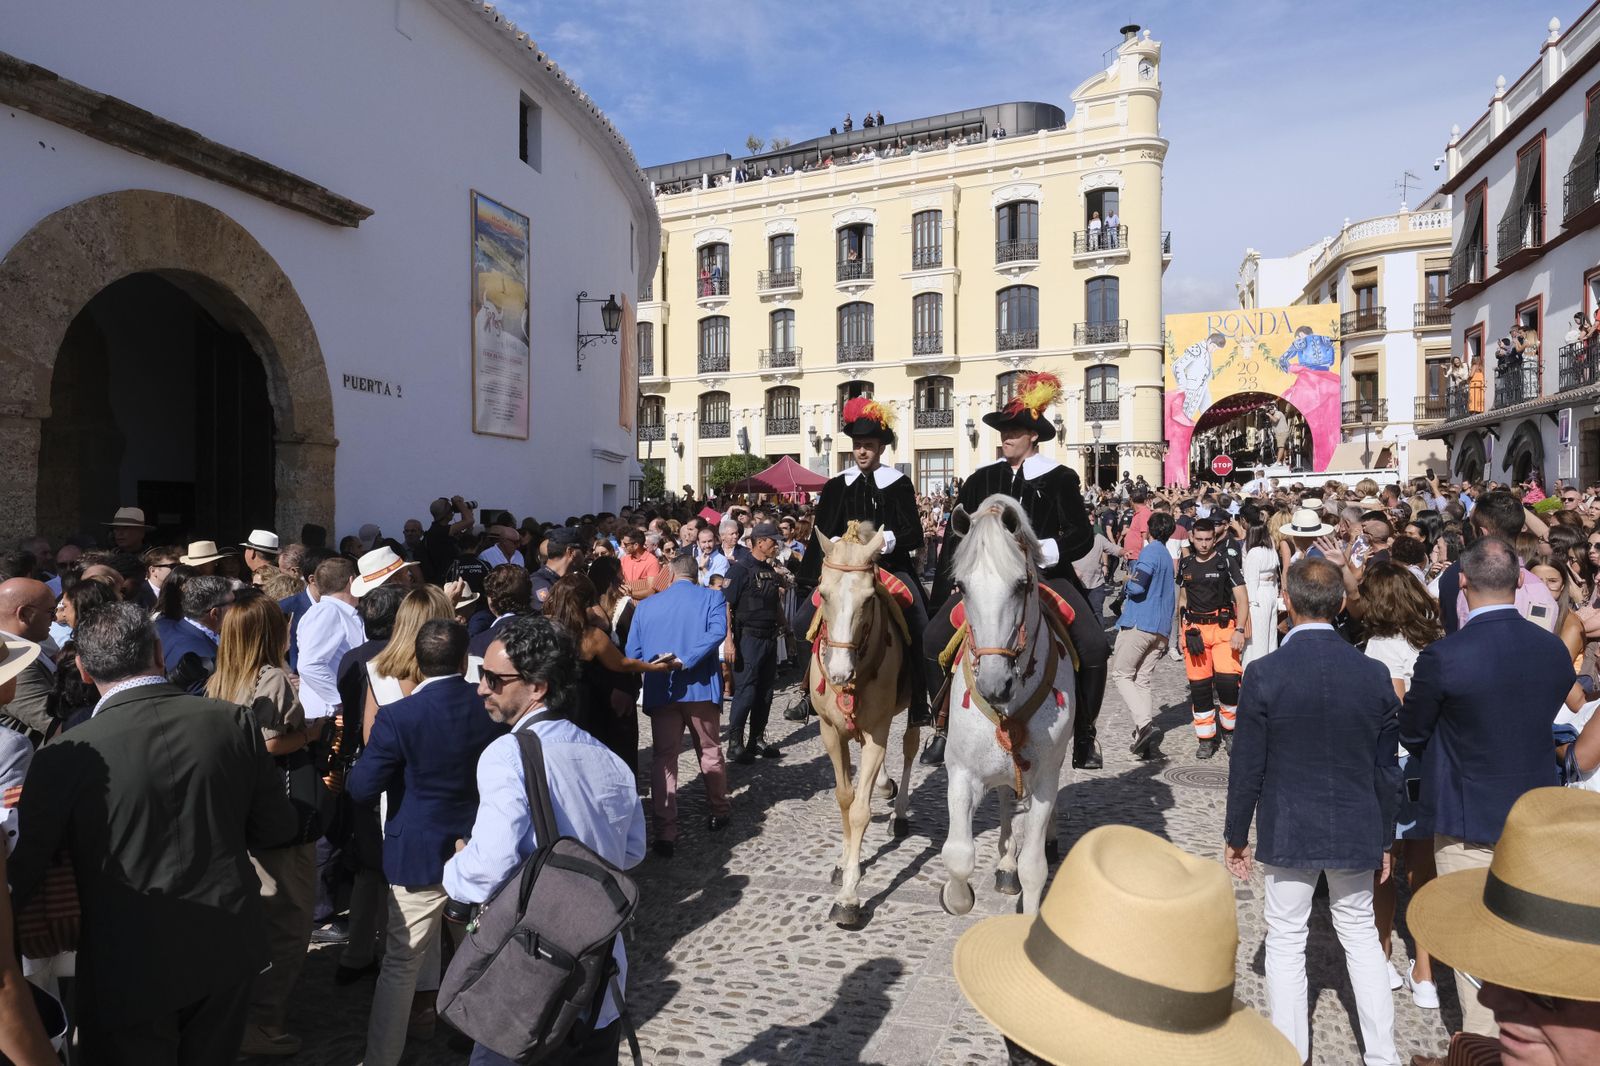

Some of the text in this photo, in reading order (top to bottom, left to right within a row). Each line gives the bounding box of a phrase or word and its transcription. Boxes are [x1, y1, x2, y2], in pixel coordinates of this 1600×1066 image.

[1208, 311, 1293, 338] RONDA
[1237, 361, 1259, 375] 20
[343, 374, 391, 396] PUERTA
[1238, 376, 1258, 390] 23
